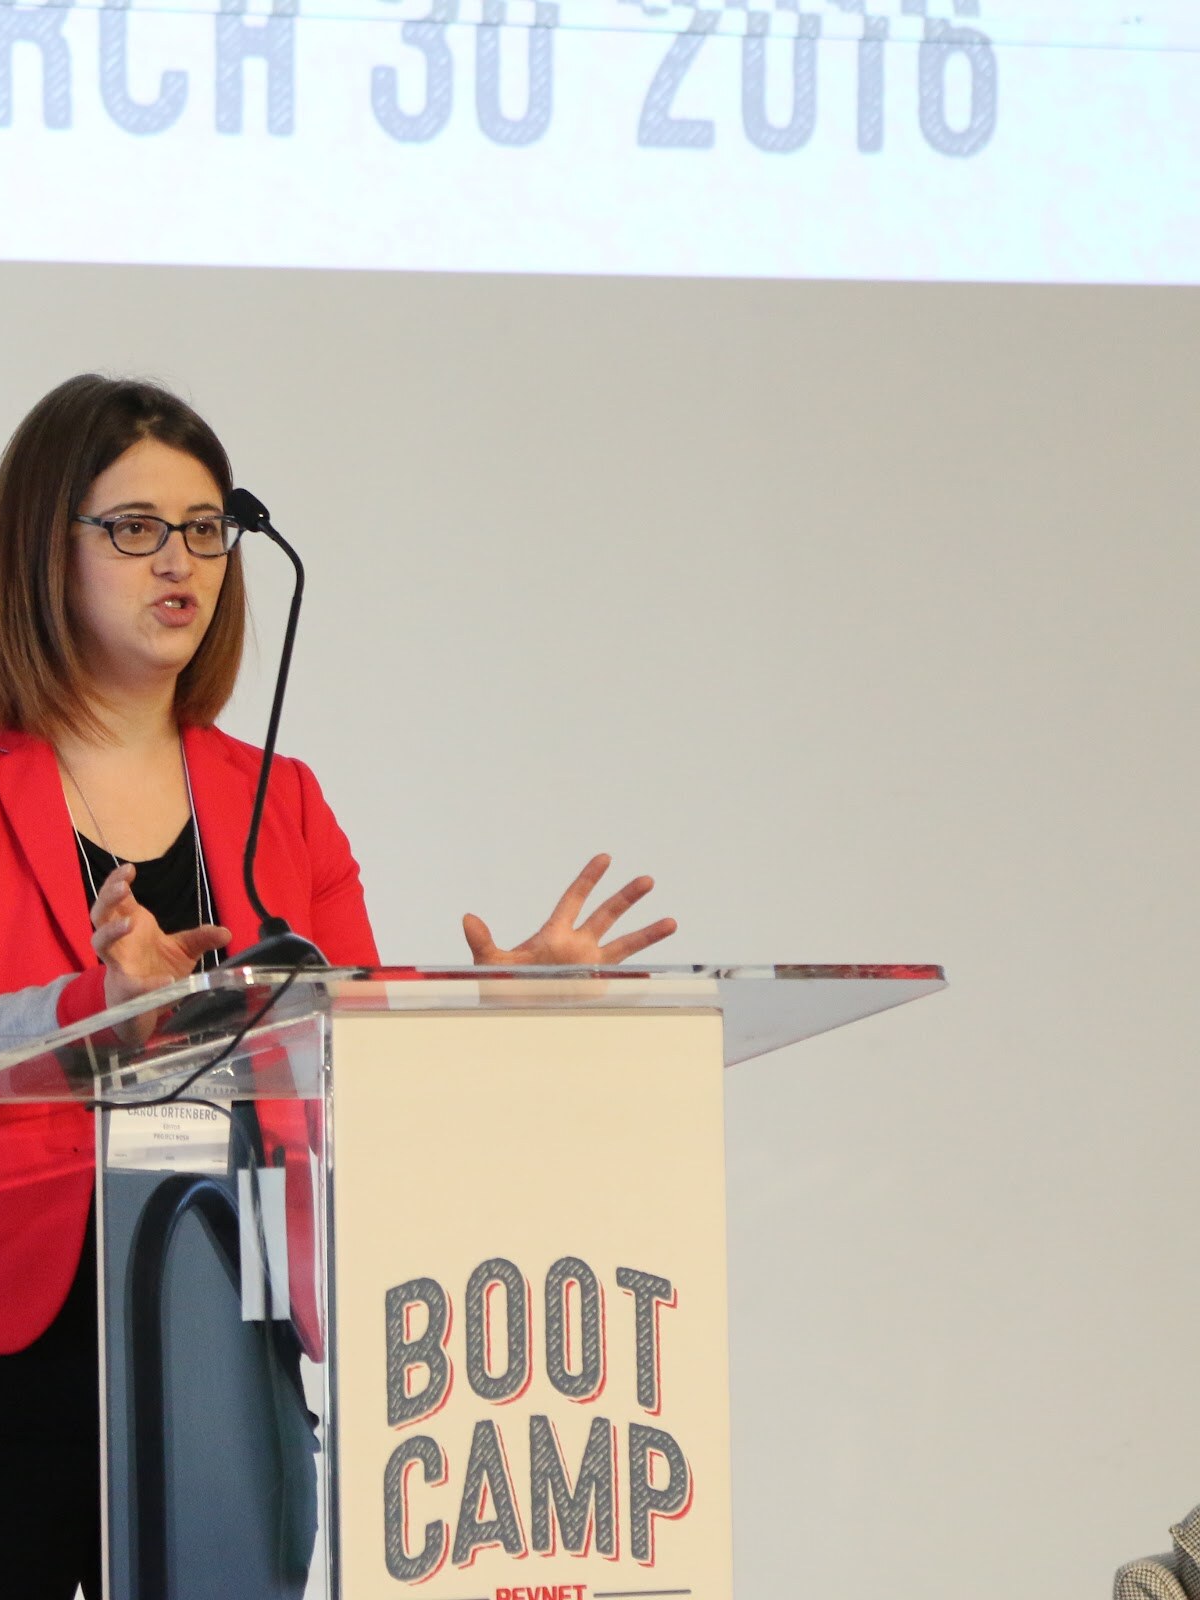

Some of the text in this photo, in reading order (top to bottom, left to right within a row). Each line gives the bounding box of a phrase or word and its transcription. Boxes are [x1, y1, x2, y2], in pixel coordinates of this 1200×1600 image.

[370, 0, 554, 147] 30
[637, 0, 998, 158] 2016
[160, 1106, 218, 1121] ORTENBERG
[385, 1256, 678, 1431] BOOT
[383, 1414, 694, 1586] CAMP
